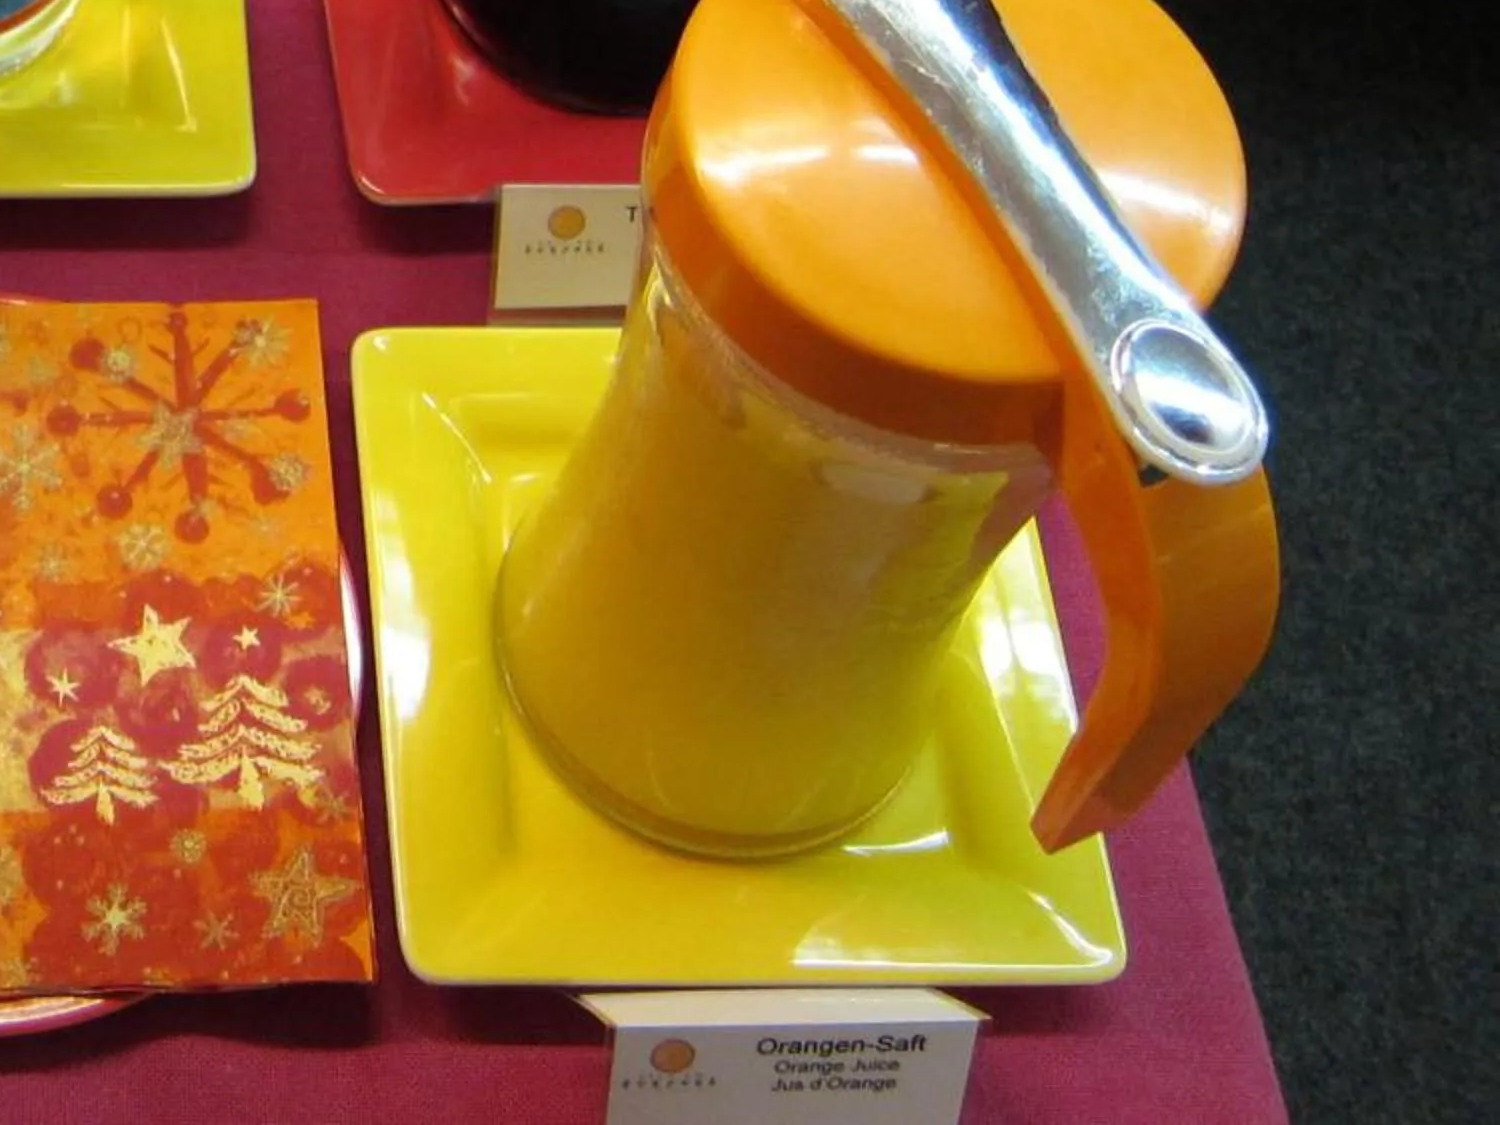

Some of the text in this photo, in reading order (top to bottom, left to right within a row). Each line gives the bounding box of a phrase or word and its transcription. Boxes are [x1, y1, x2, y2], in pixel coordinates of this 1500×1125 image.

[756, 1034, 928, 1057] Orangen-Saft
[774, 1058, 901, 1075] Orange Juice
[771, 1078, 805, 1092] Jus
